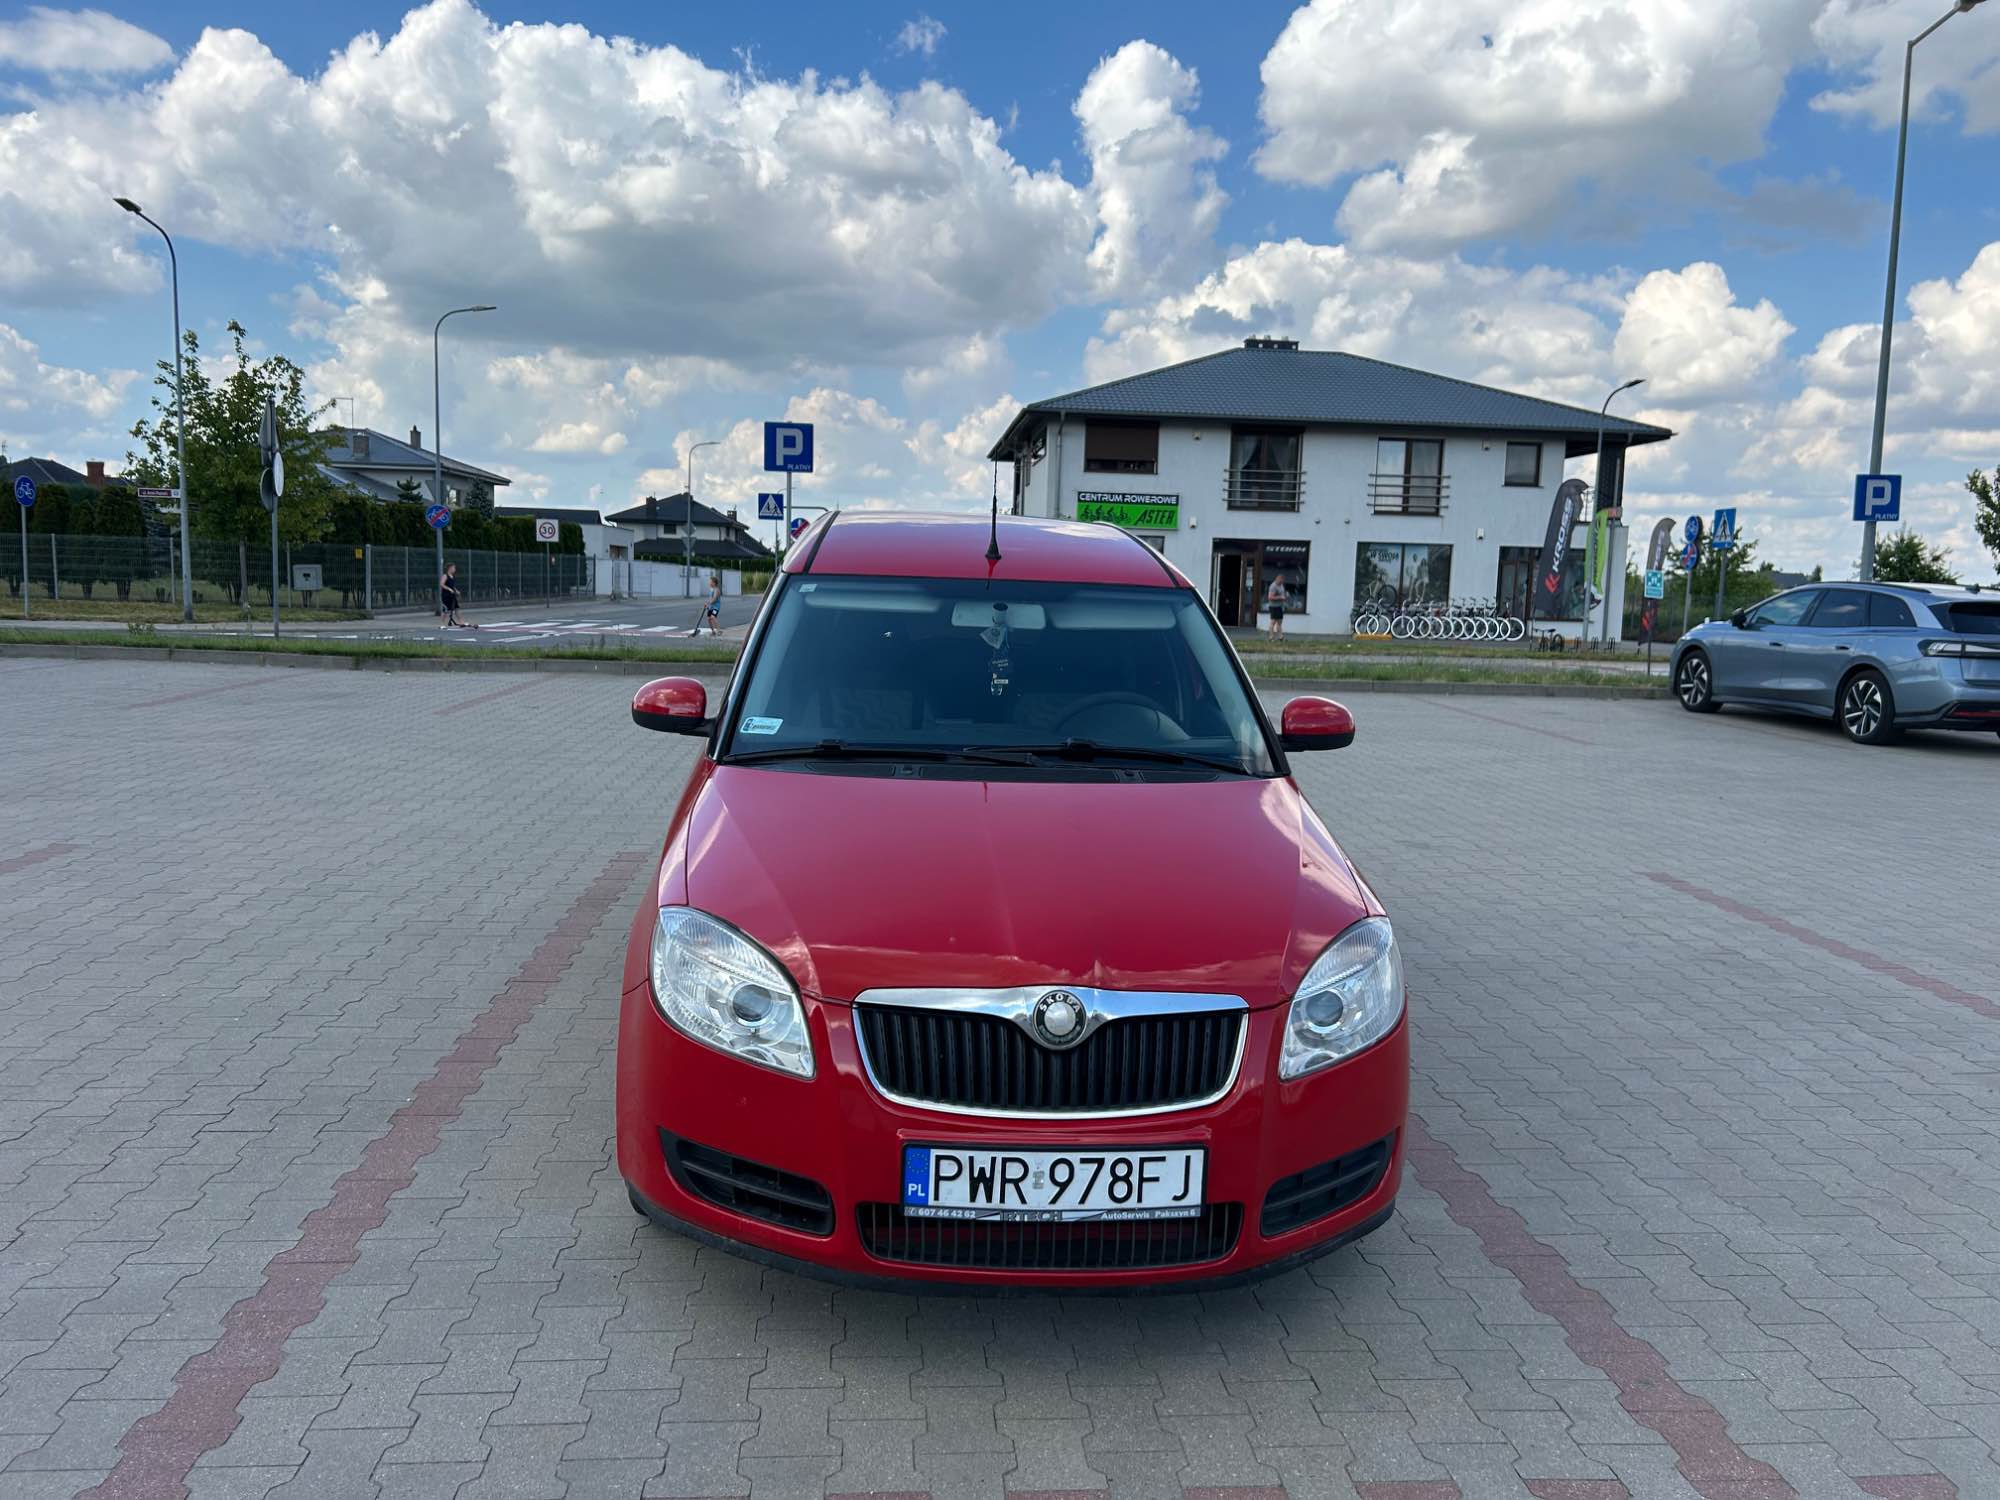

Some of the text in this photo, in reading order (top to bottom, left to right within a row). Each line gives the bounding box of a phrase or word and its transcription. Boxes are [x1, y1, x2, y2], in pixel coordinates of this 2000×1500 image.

[776, 427, 804, 466] P
[1079, 492, 1177, 504] CENTRUM ROWEROWE
[1864, 479, 1892, 516] P
[1134, 509, 1175, 525] ASTER
[542, 526, 553, 535] 30
[933, 1154, 1192, 1205] PWR 978FJ
[908, 1183, 925, 1196] PL
[918, 1207, 935, 1216] 607
